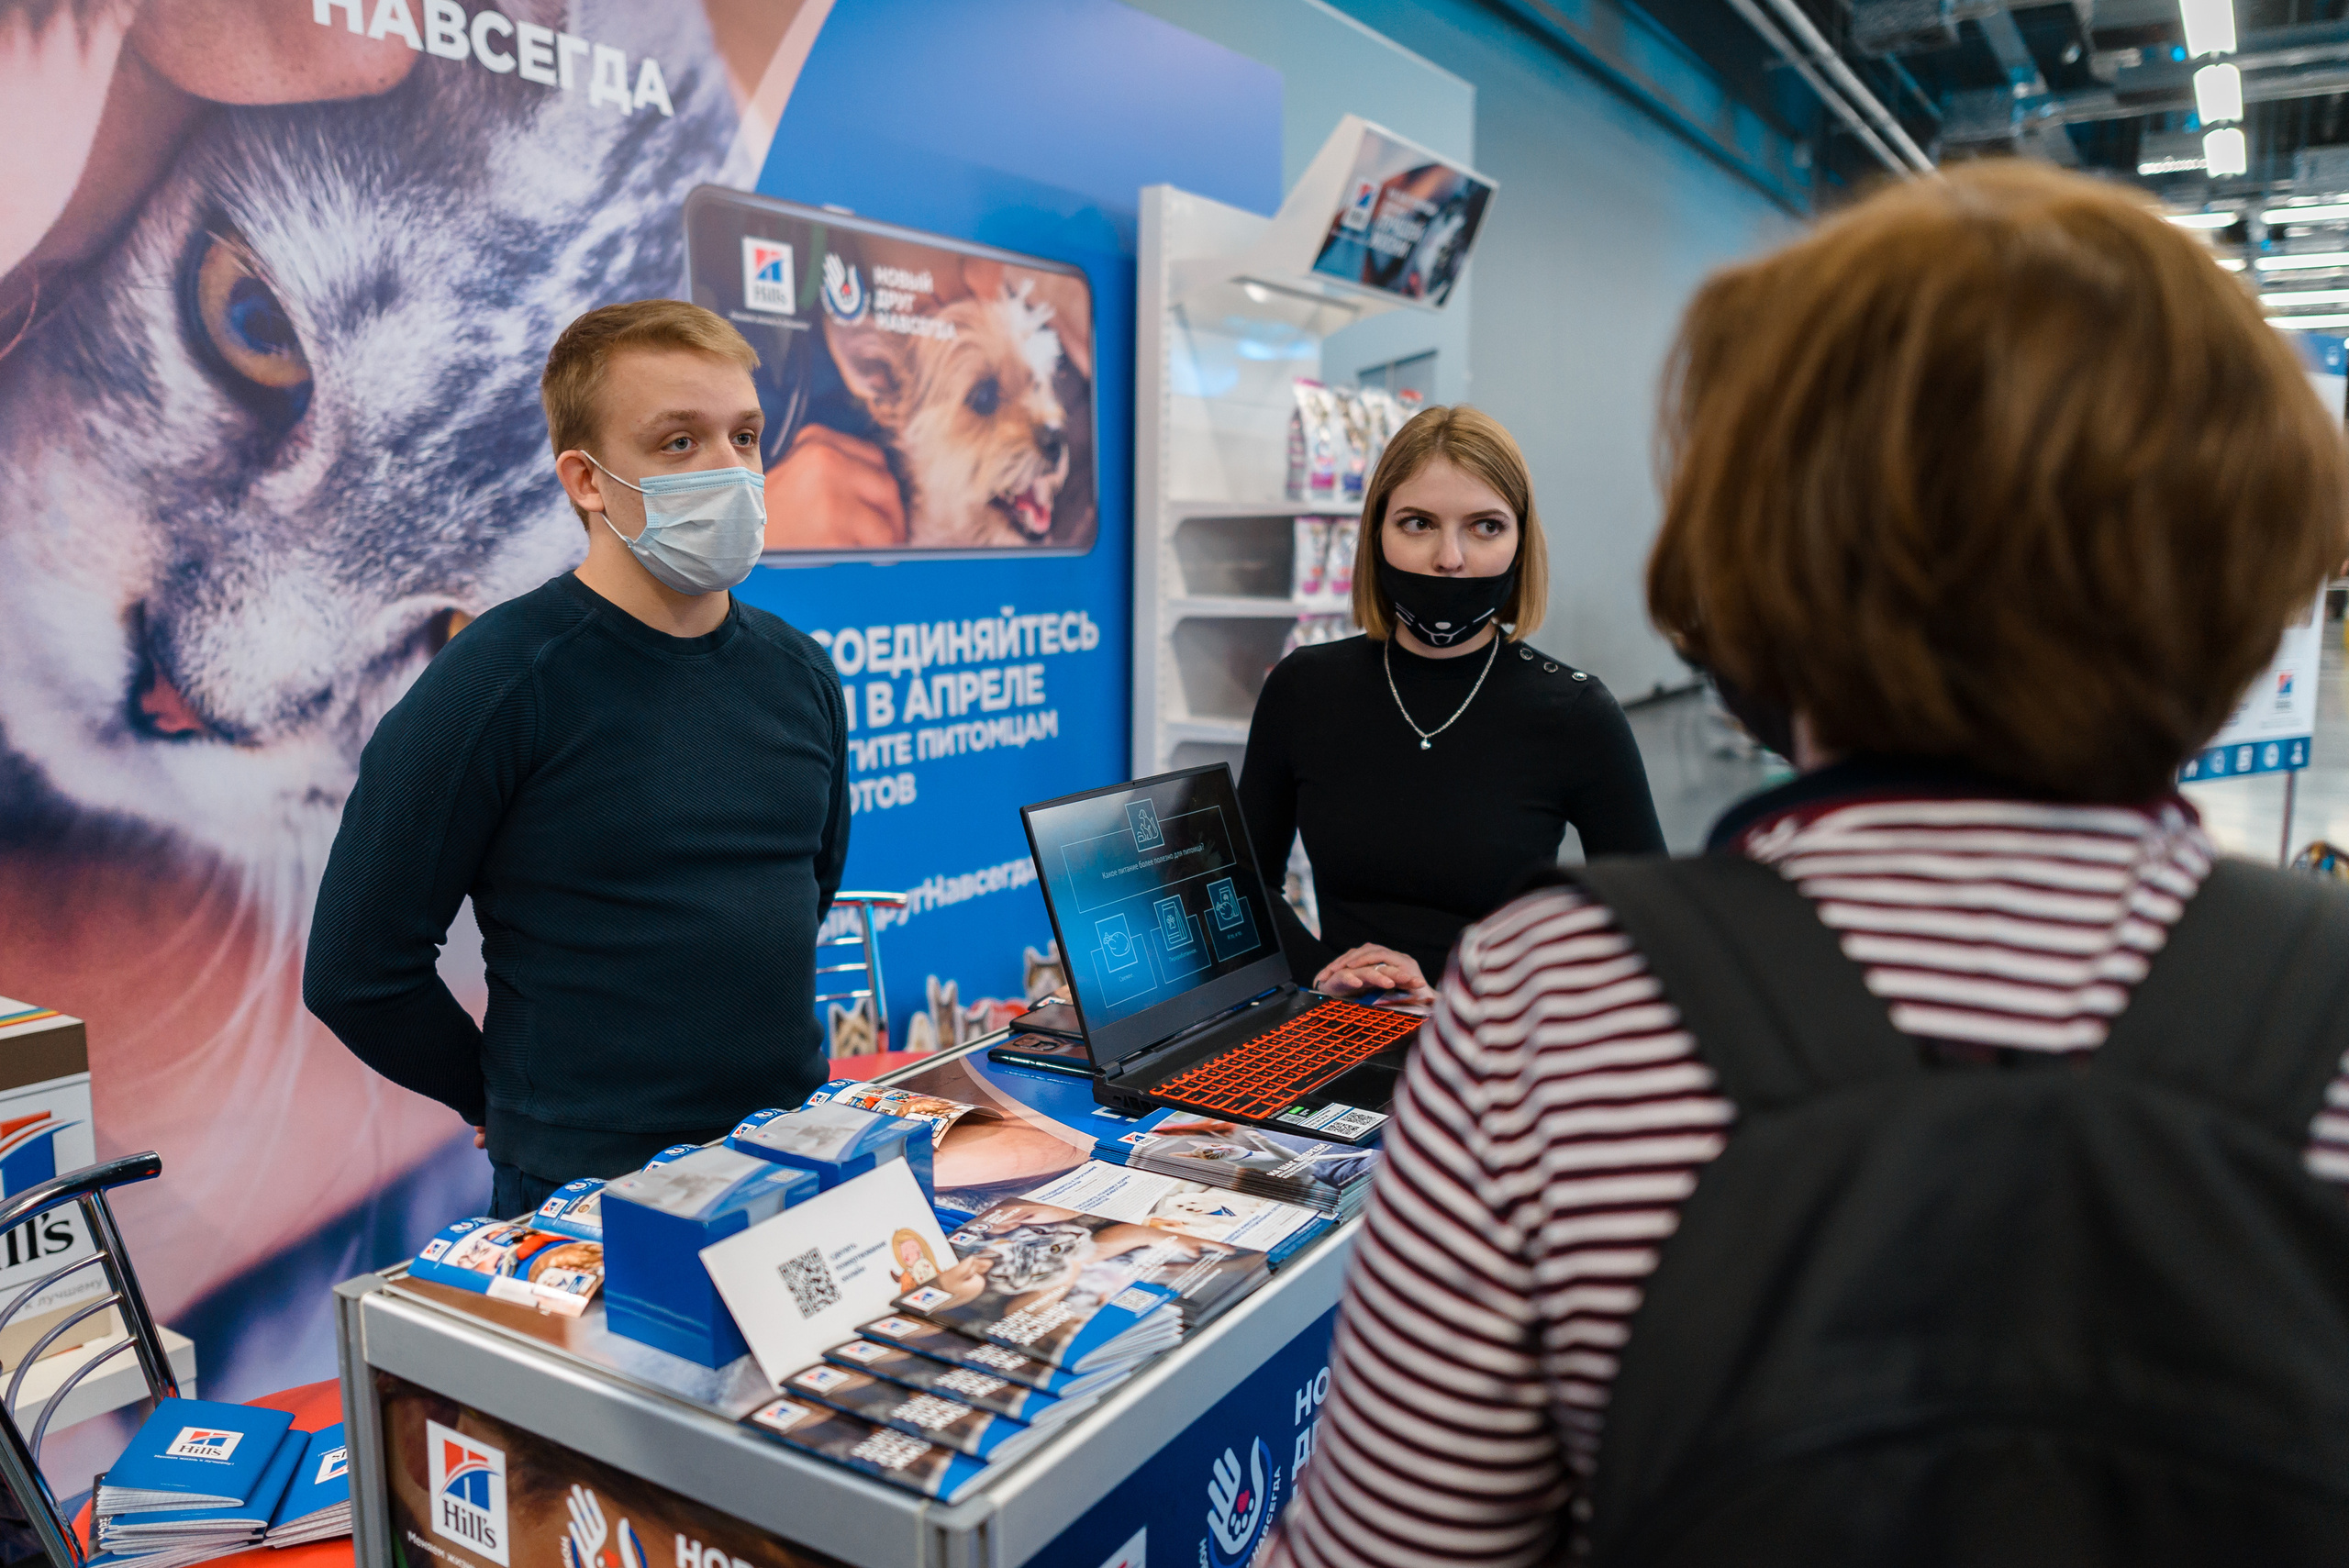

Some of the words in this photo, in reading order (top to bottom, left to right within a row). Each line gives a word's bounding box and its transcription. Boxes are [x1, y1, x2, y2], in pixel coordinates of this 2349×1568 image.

[312, 0, 675, 117] НАВСЕГДА
[865, 681, 896, 729] В
[902, 662, 1047, 724] АПРЕЛЕ
[917, 709, 1059, 762] ПИТОМЦАМ
[179, 1445, 222, 1457] Hill's
[442, 1498, 497, 1550] Hill's
